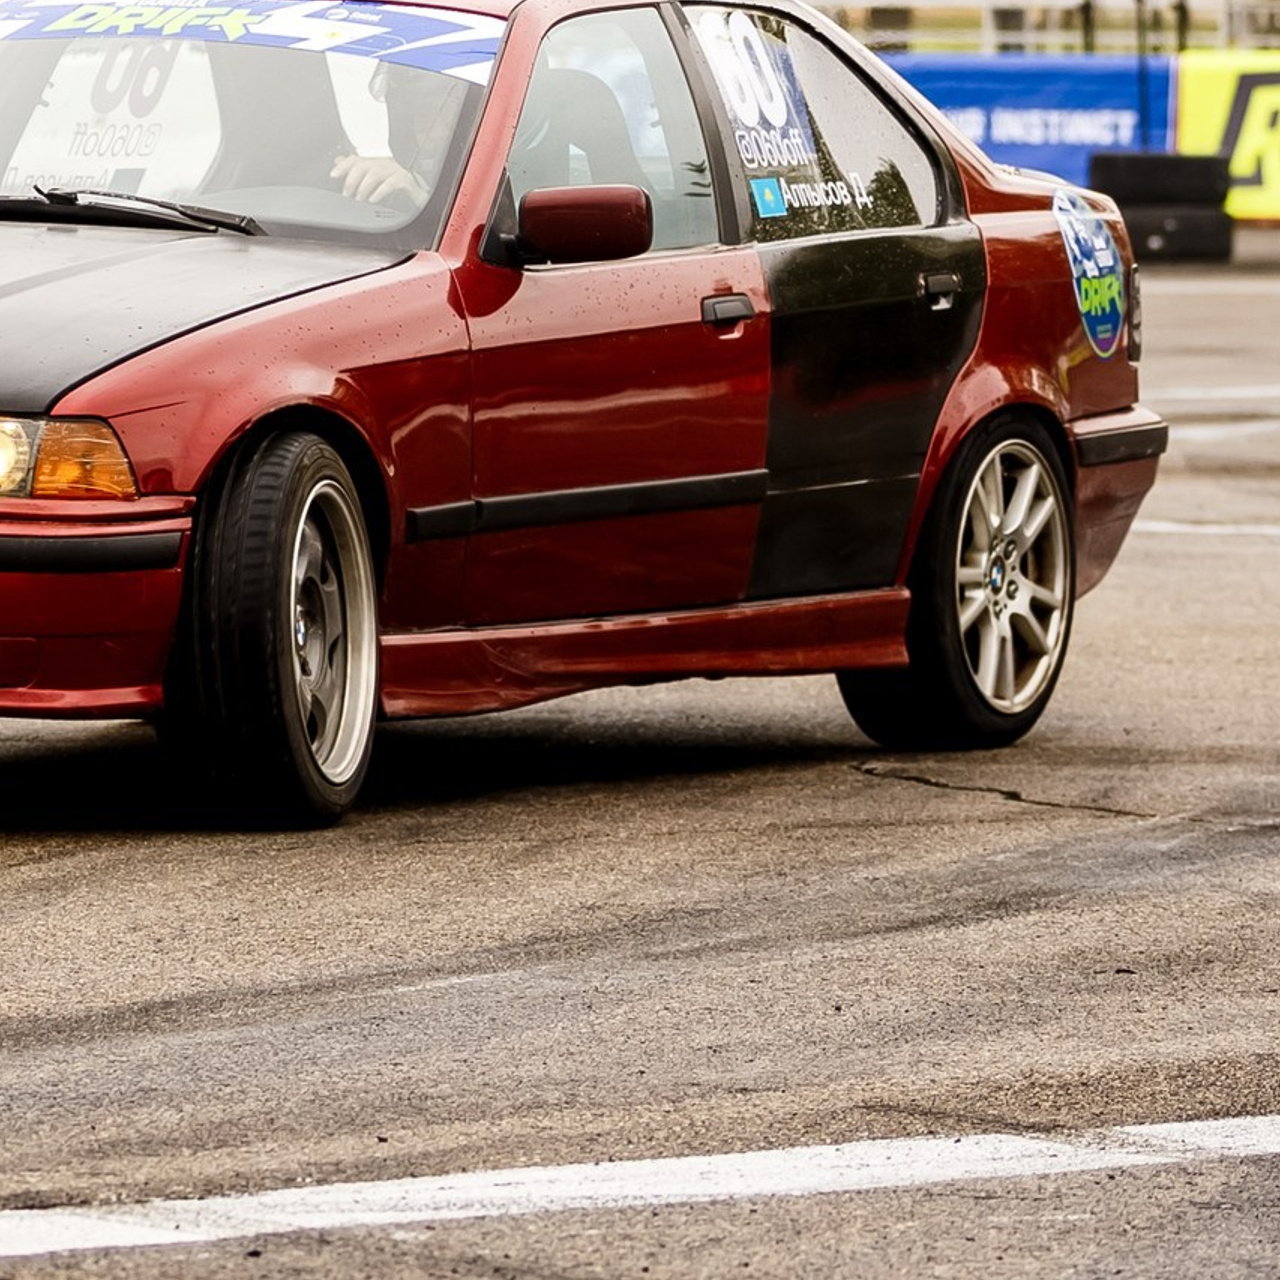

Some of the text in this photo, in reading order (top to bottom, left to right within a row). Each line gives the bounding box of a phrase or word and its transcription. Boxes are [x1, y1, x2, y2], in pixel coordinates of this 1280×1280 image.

[41, 4, 272, 41] DRIFT
[699, 10, 787, 127] 60
[735, 129, 809, 169] @060off
